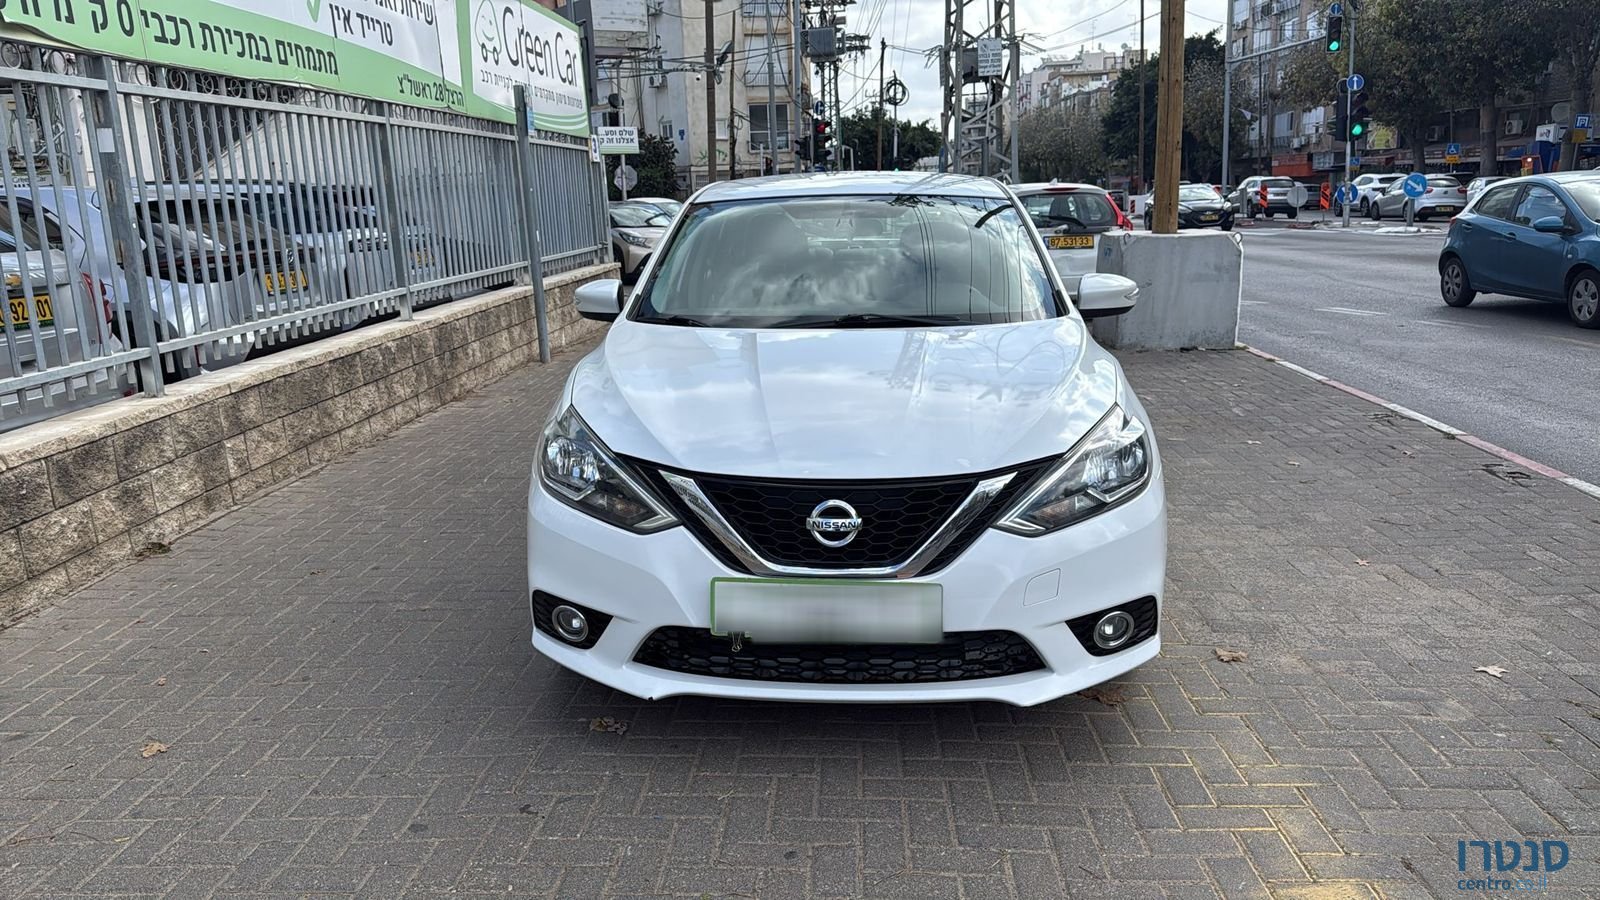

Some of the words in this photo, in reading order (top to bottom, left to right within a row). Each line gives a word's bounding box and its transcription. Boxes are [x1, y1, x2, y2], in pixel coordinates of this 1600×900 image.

[140, 9, 196, 49] רכבי
[329, 3, 354, 39] אין
[356, 12, 393, 46] טרייד
[199, 21, 273, 63] במכירת
[502, 6, 555, 79] Green
[555, 31, 578, 88] Car
[275, 39, 339, 76] מתמחים
[397, 72, 433, 100] ראשל"צ
[433, 81, 444, 102] 28
[480, 69, 494, 86] רכב
[444, 83, 465, 107] הרצל
[615, 136, 635, 144] אצלנו
[618, 129, 634, 137] שלם
[812, 520, 856, 529] NISSAN
